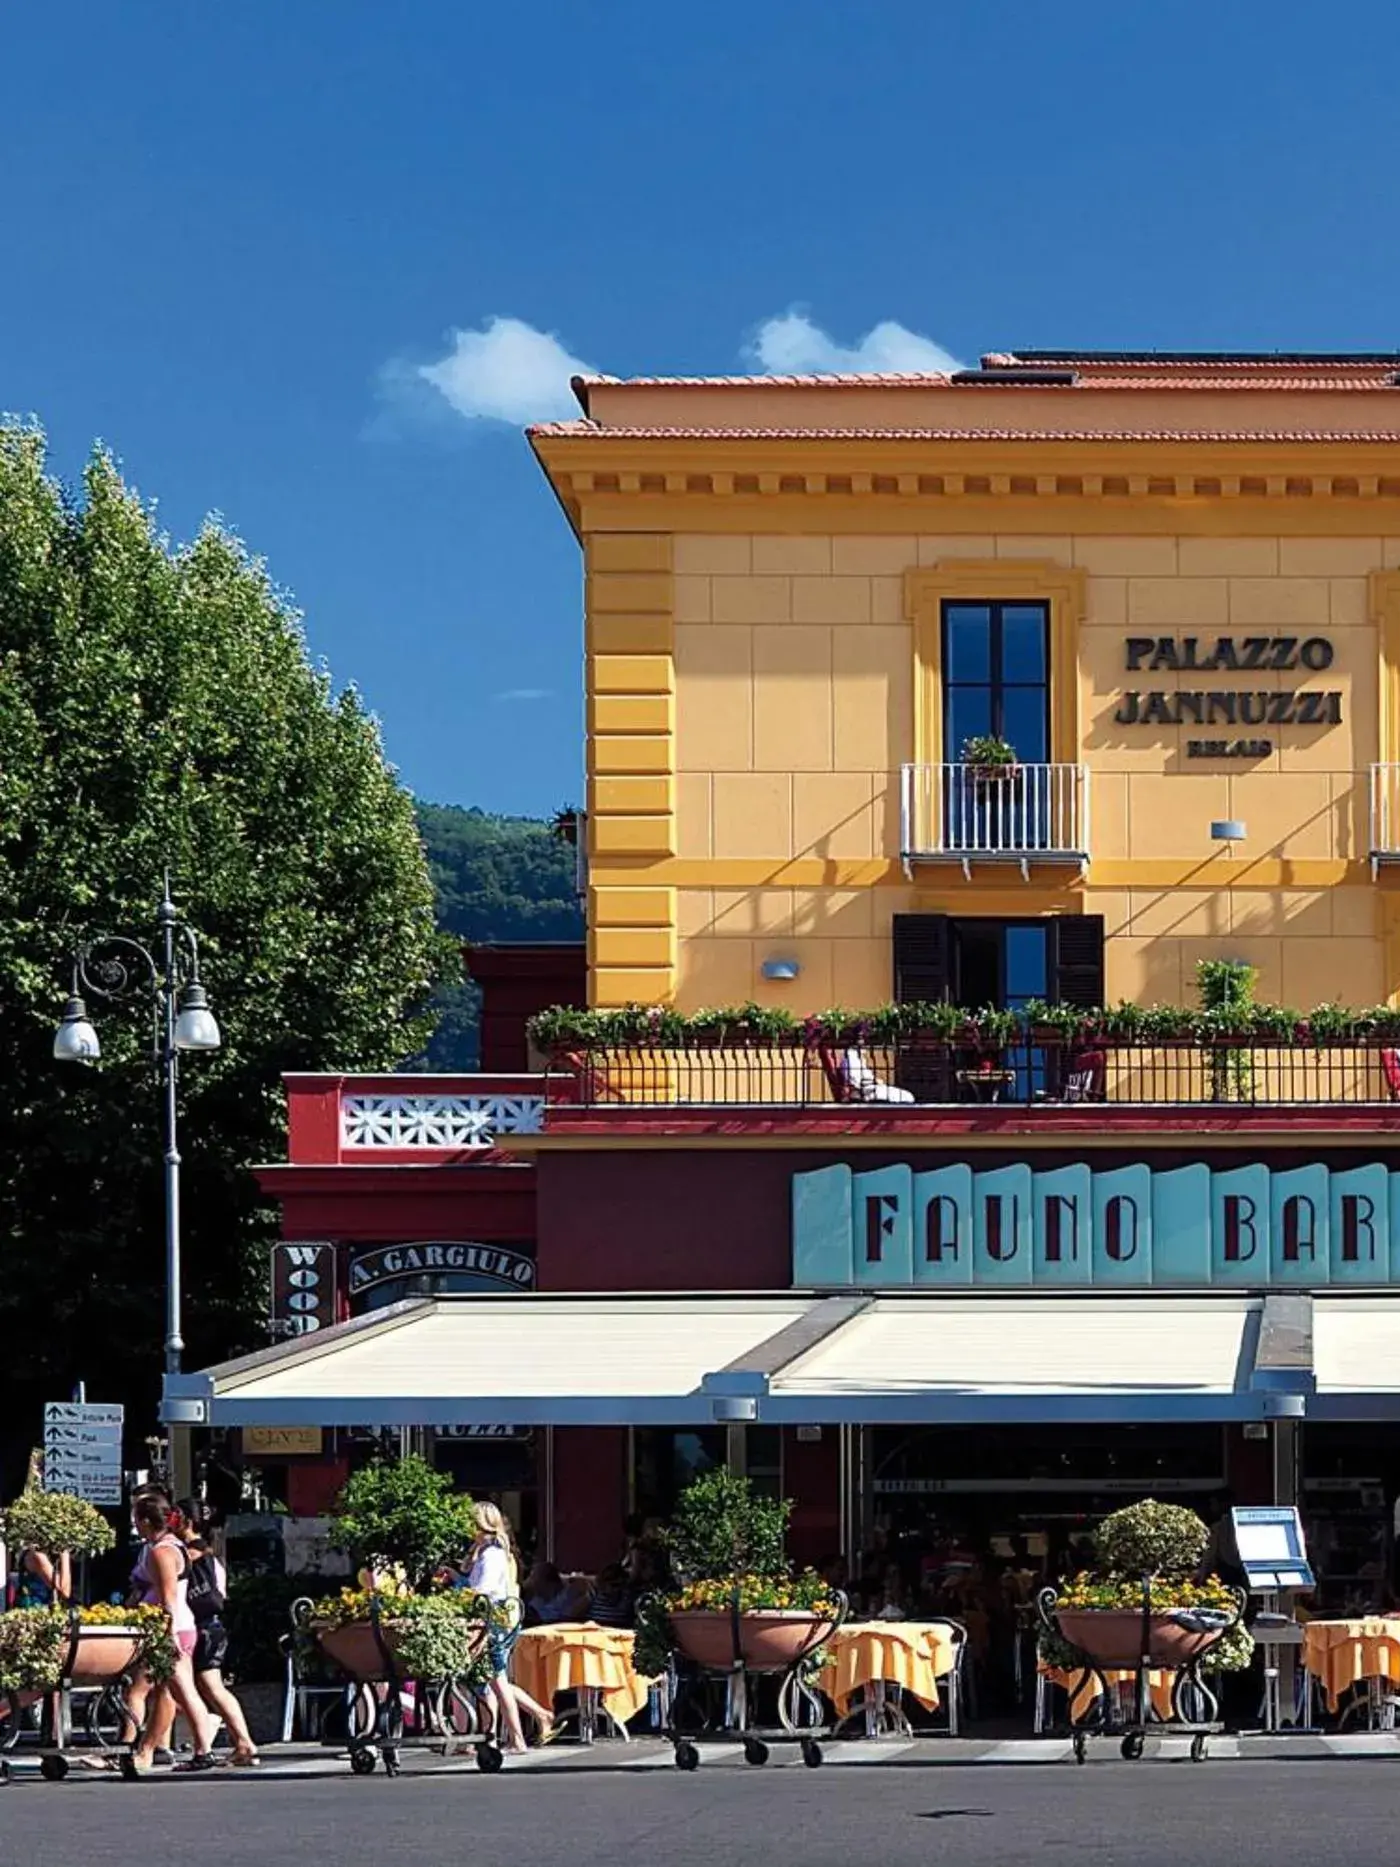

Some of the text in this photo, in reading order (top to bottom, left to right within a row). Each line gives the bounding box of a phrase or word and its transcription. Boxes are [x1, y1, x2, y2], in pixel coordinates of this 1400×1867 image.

[1125, 637, 1334, 671] PALAZZO
[1114, 691, 1344, 725] JANNUZZI
[866, 1195, 1375, 1262] FAUNO BAR
[353, 1245, 533, 1286] A. GARGIULO
